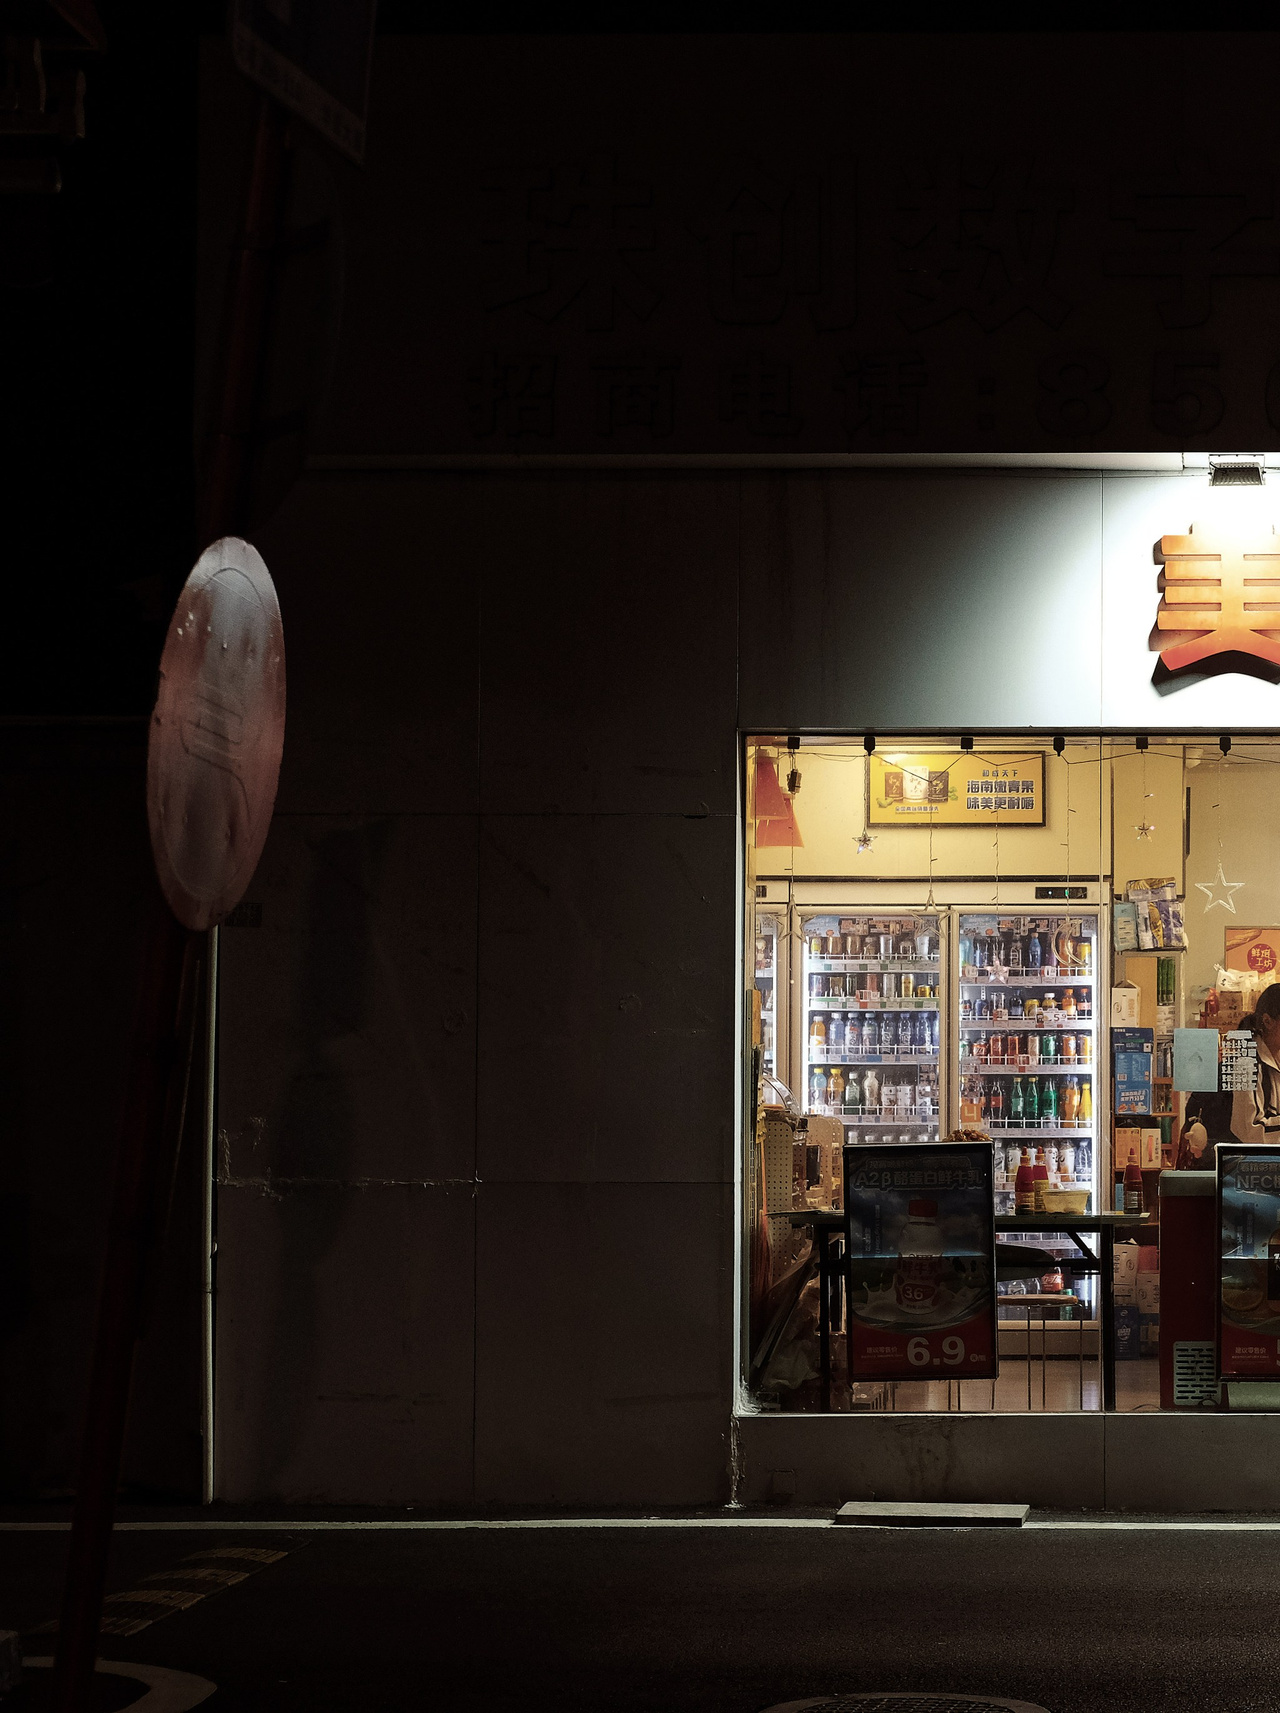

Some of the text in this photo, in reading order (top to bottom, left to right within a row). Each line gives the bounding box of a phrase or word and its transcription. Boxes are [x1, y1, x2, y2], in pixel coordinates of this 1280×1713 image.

[966, 780, 1035, 794] 海南嫩青果
[906, 1335, 966, 1367] 6.9
